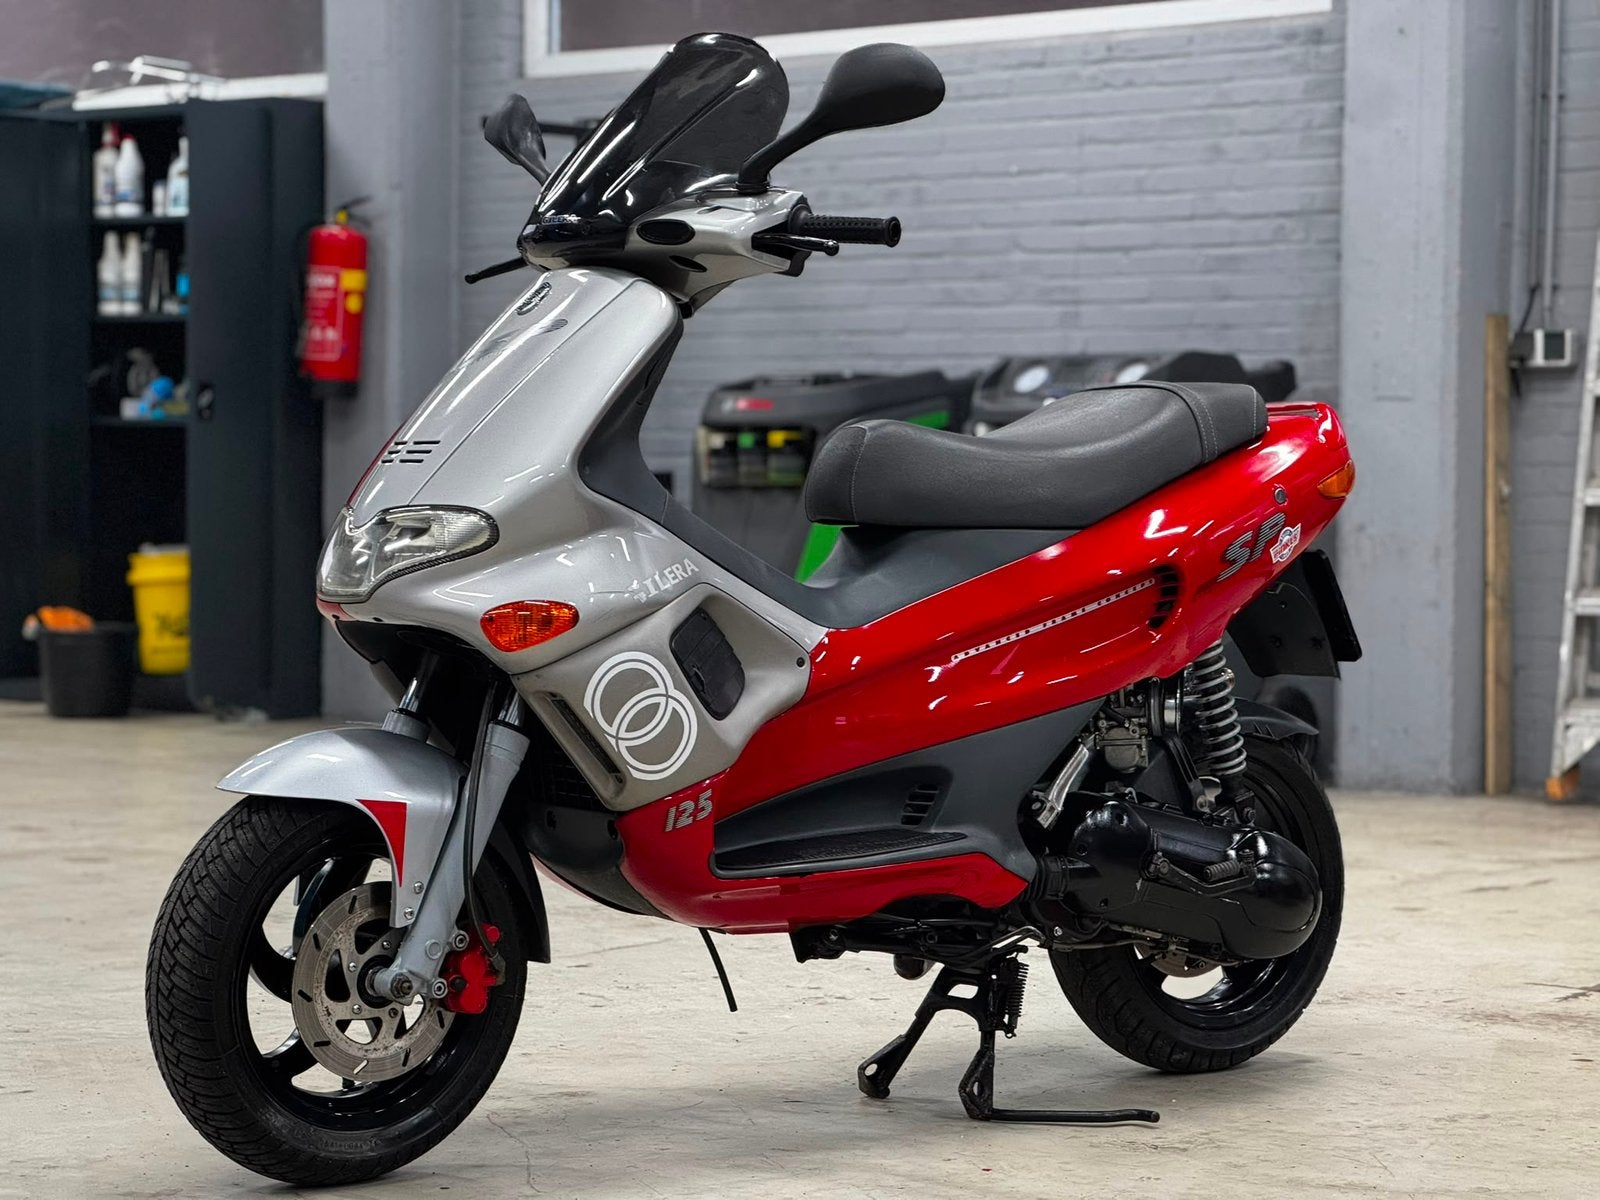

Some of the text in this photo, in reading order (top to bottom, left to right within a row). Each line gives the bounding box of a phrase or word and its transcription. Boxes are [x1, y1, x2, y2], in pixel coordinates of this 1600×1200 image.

[1216, 511, 1286, 582] SP
[953, 629, 1030, 660] ADVANCED
[1042, 607, 1086, 628] FRAME
[664, 788, 713, 832] 125
